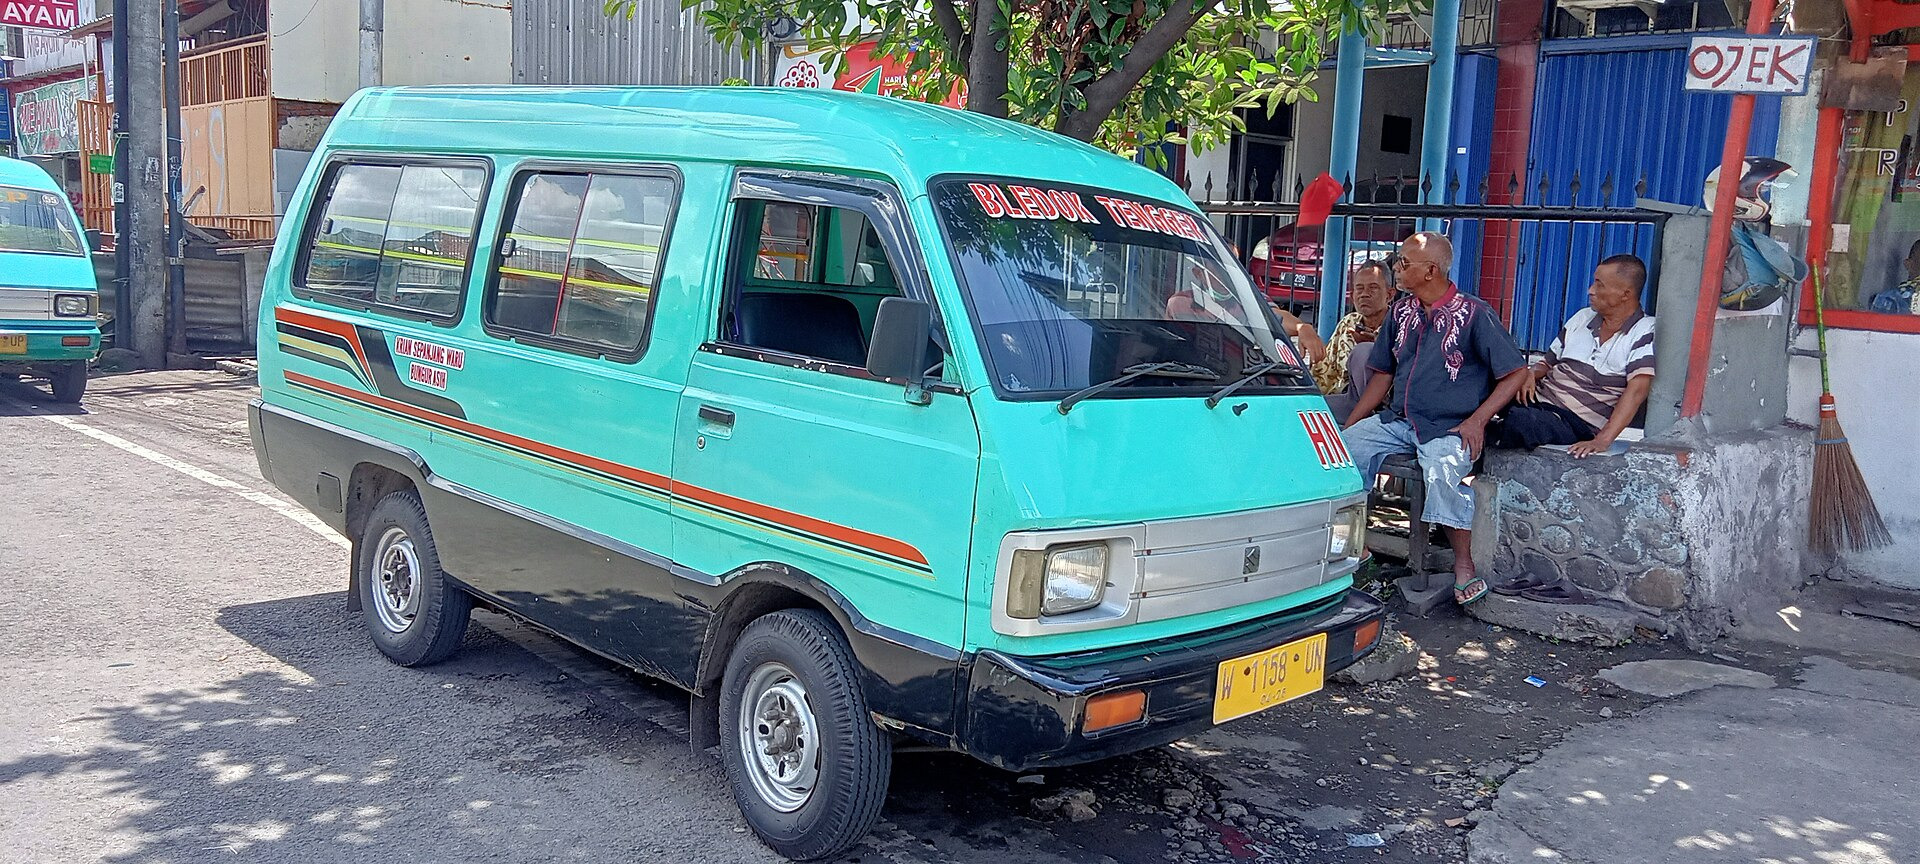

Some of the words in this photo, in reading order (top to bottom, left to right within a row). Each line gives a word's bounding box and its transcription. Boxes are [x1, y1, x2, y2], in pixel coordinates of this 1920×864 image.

[3, 2, 75, 27] AYAM
[1689, 44, 1807, 88] OJEK
[968, 183, 1100, 225] BLEDOK
[1095, 195, 1211, 245] TENGGER
[10, 335, 25, 347] UP
[396, 337, 413, 356] KRIAN
[413, 341, 445, 364] SEPANJANG
[446, 348, 464, 369] WARU
[1297, 411, 1354, 469] HN
[1221, 664, 1235, 701] W
[1251, 650, 1288, 693] 1158
[1304, 640, 1325, 674] UN
